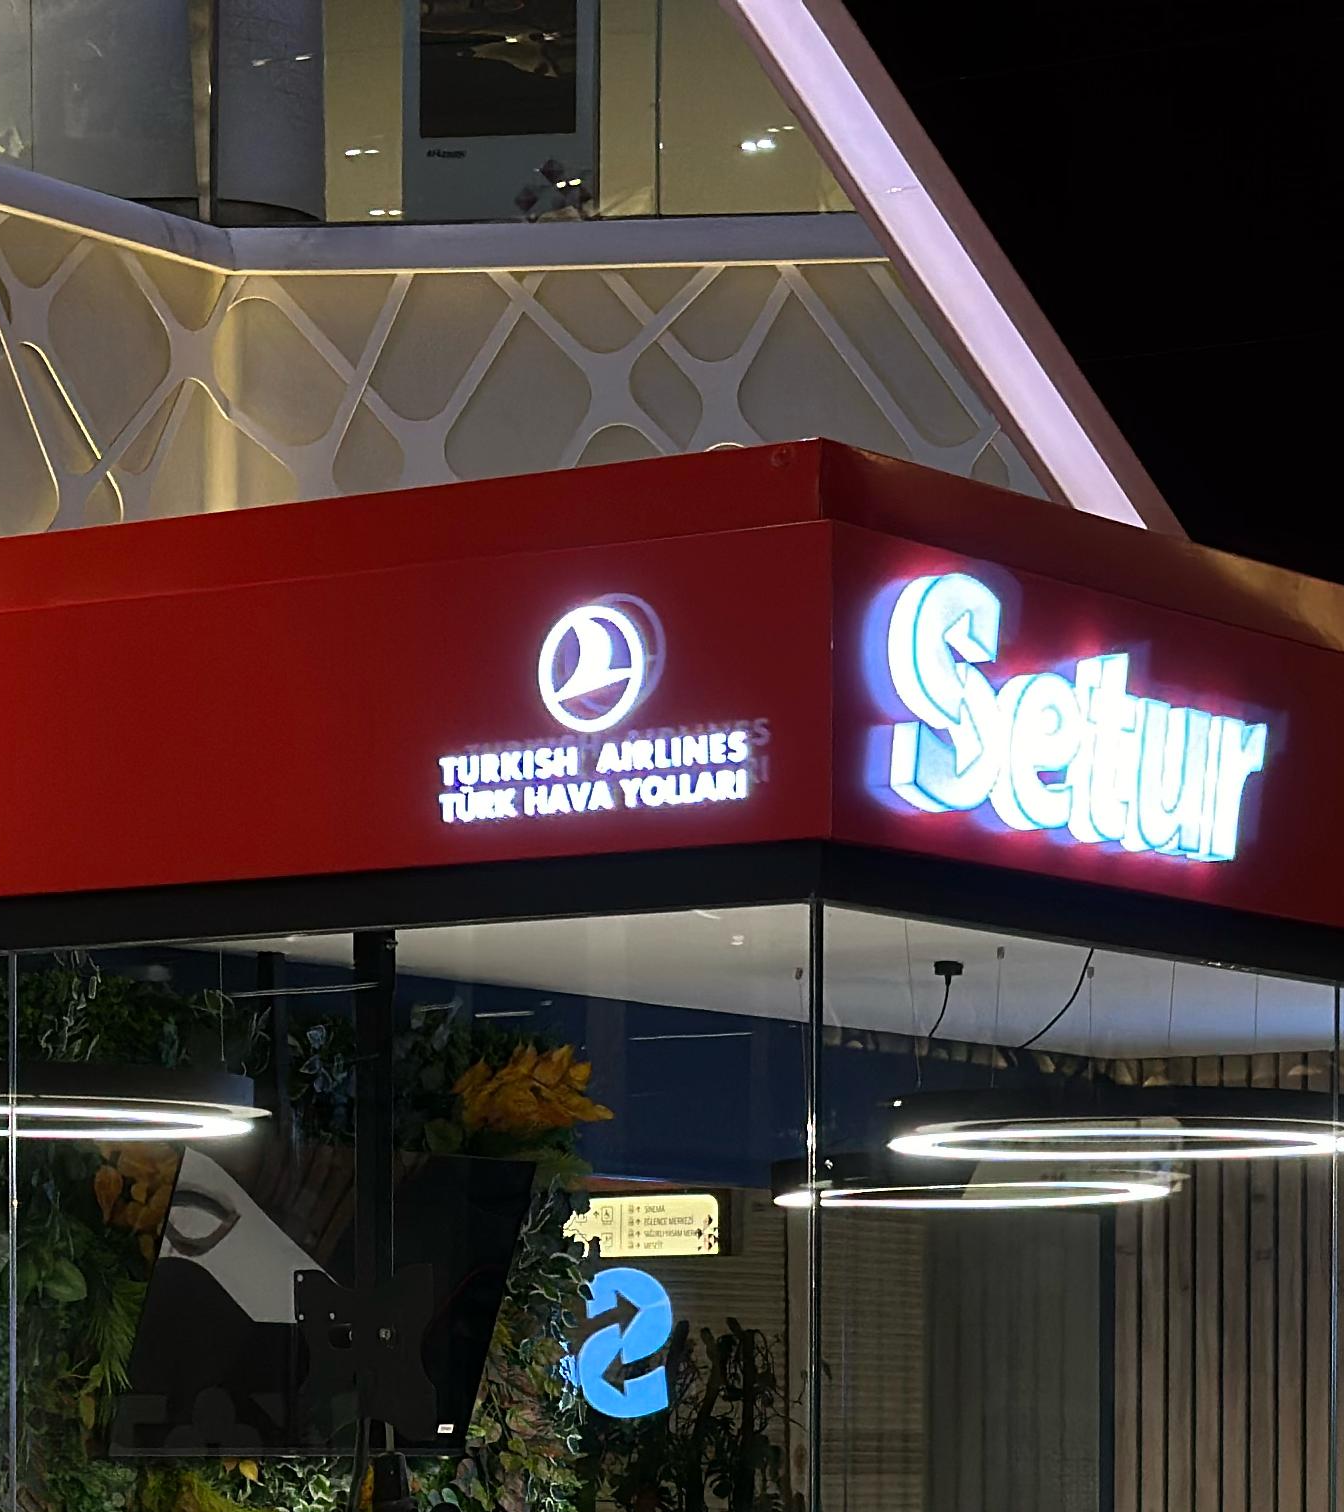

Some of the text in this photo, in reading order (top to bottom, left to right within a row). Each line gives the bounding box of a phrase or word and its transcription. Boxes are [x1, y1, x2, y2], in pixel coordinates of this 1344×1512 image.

[888, 572, 1268, 863] Setur
[439, 731, 749, 787] TURKISH AIRLINES
[439, 768, 748, 824] TÜRK HAVA YOLLARI
